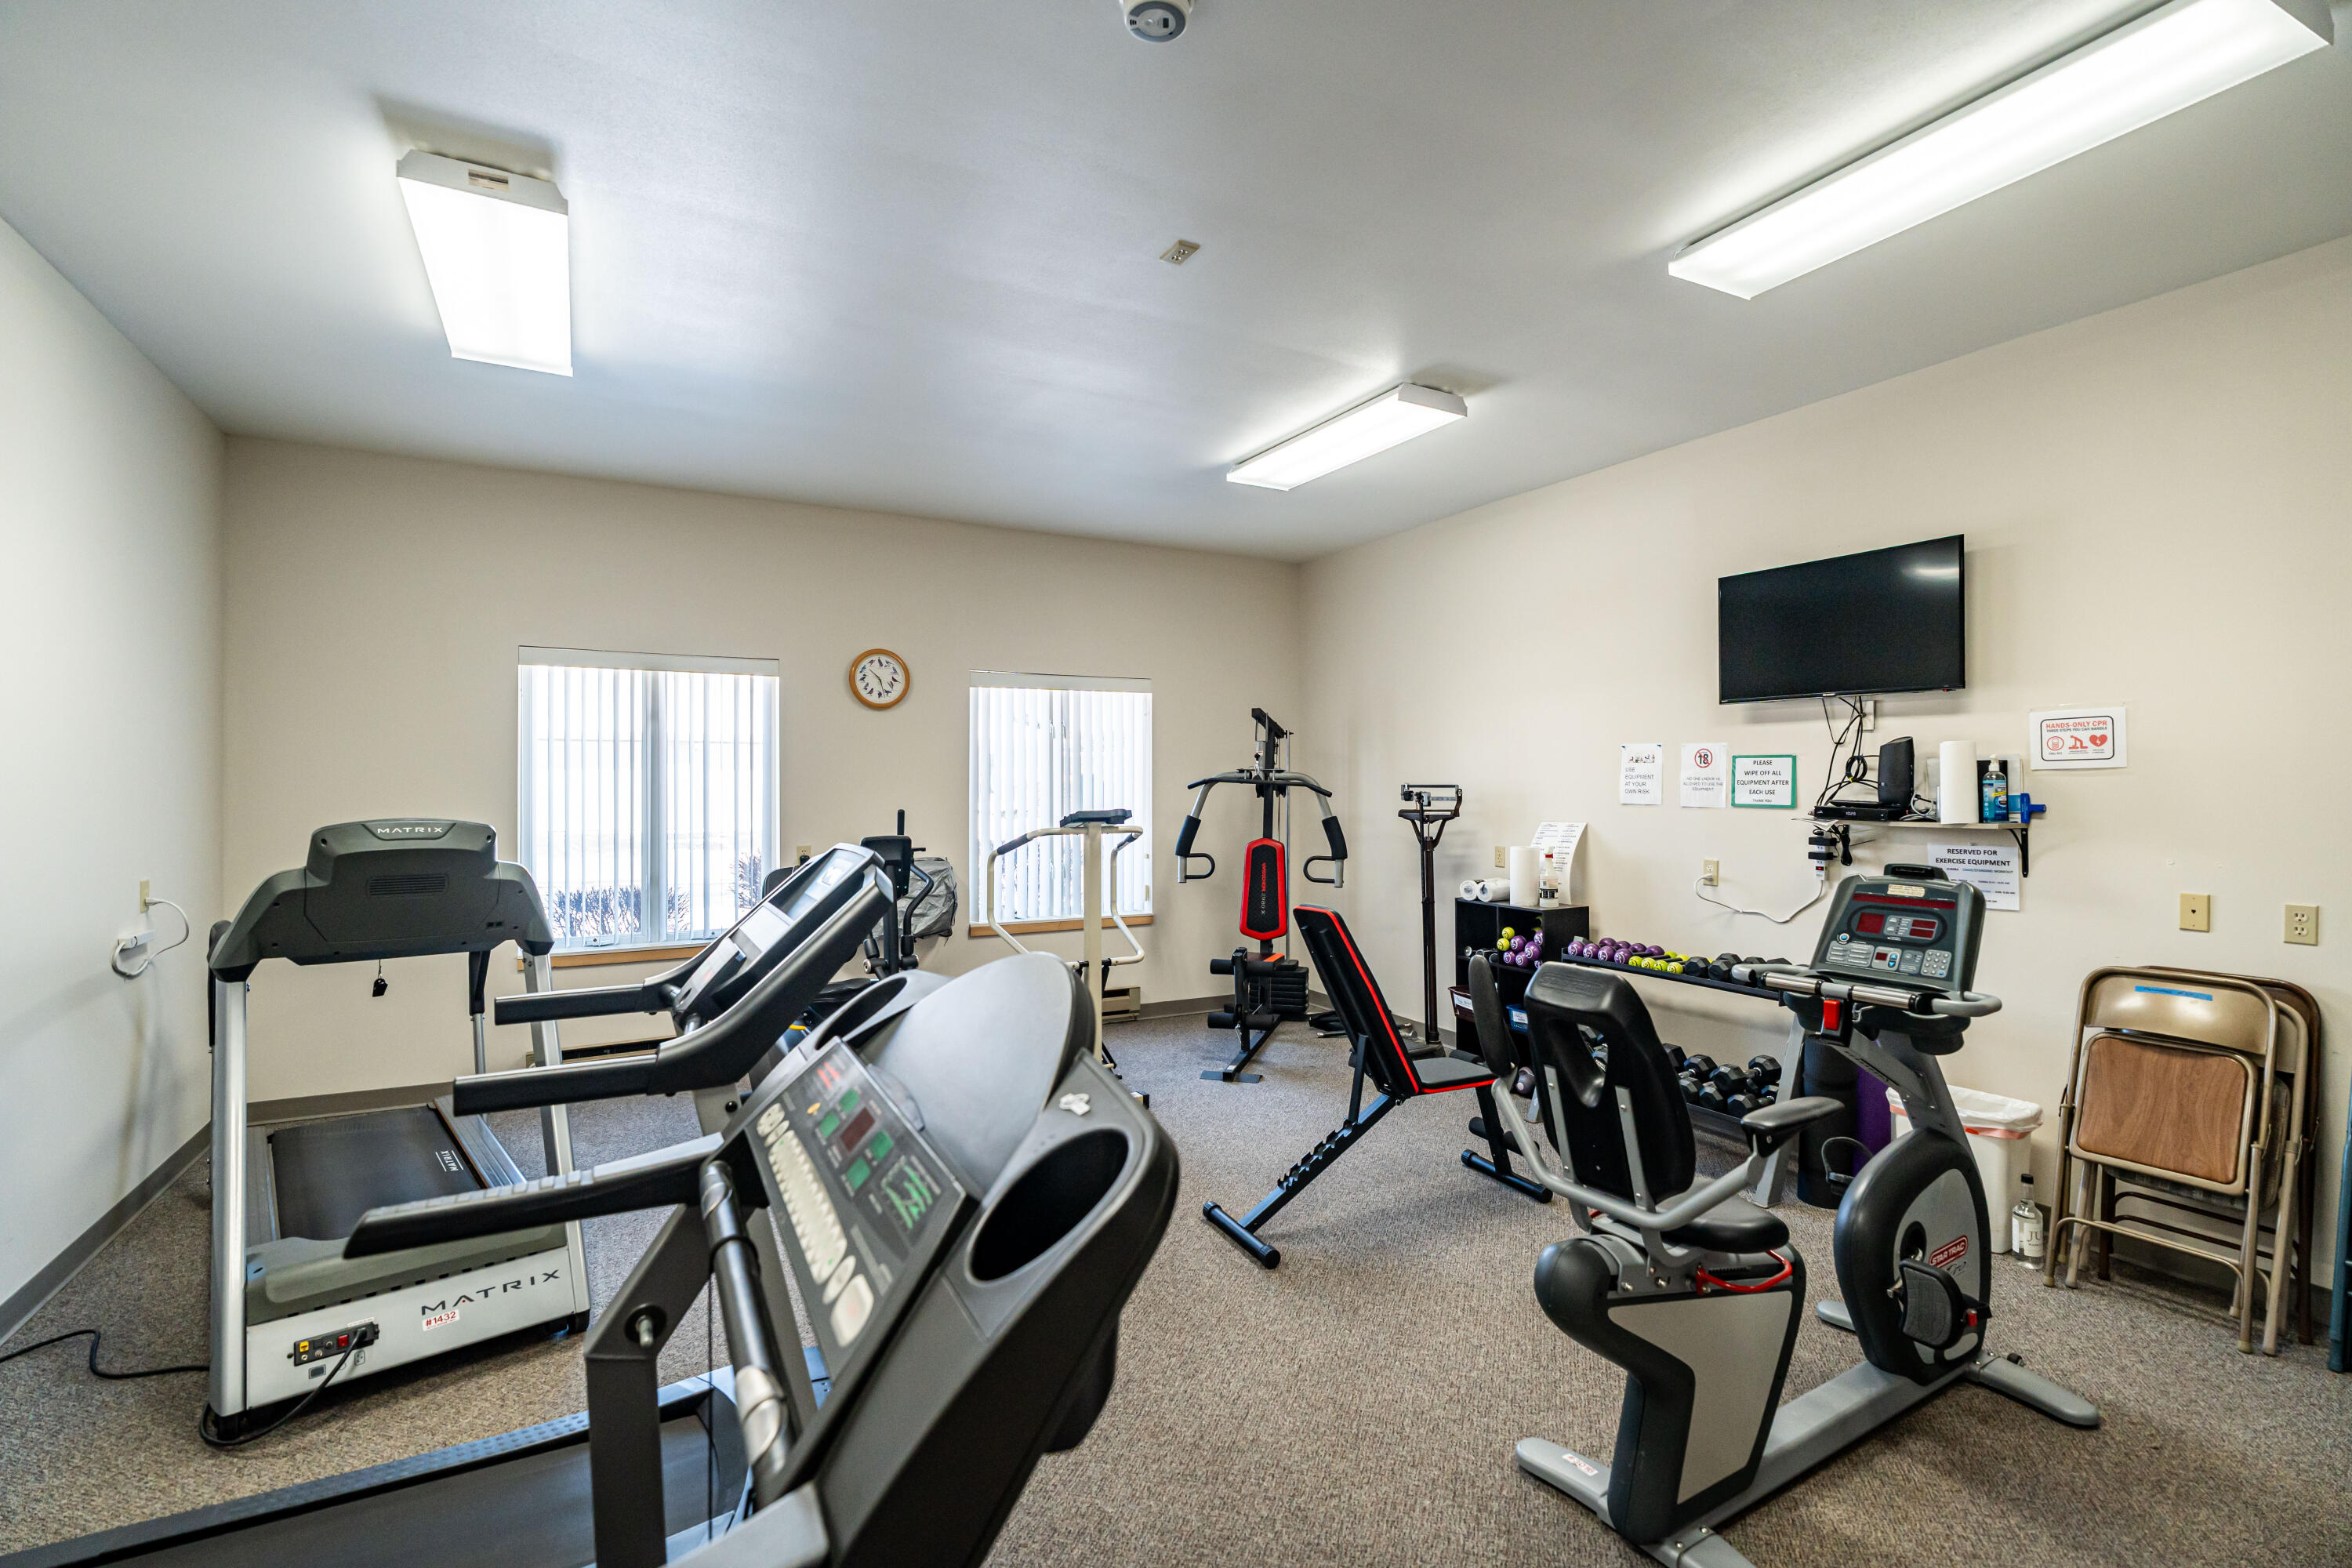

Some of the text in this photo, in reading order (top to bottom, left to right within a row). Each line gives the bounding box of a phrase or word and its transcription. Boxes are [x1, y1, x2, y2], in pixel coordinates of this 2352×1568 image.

[1697, 753, 1709, 764] 18
[440, 1150, 459, 1171] MATRIX
[1932, 1242, 1965, 1264] STAR TRAC
[421, 1269, 561, 1316] MATRIX
[426, 1311, 456, 1327] #1432
